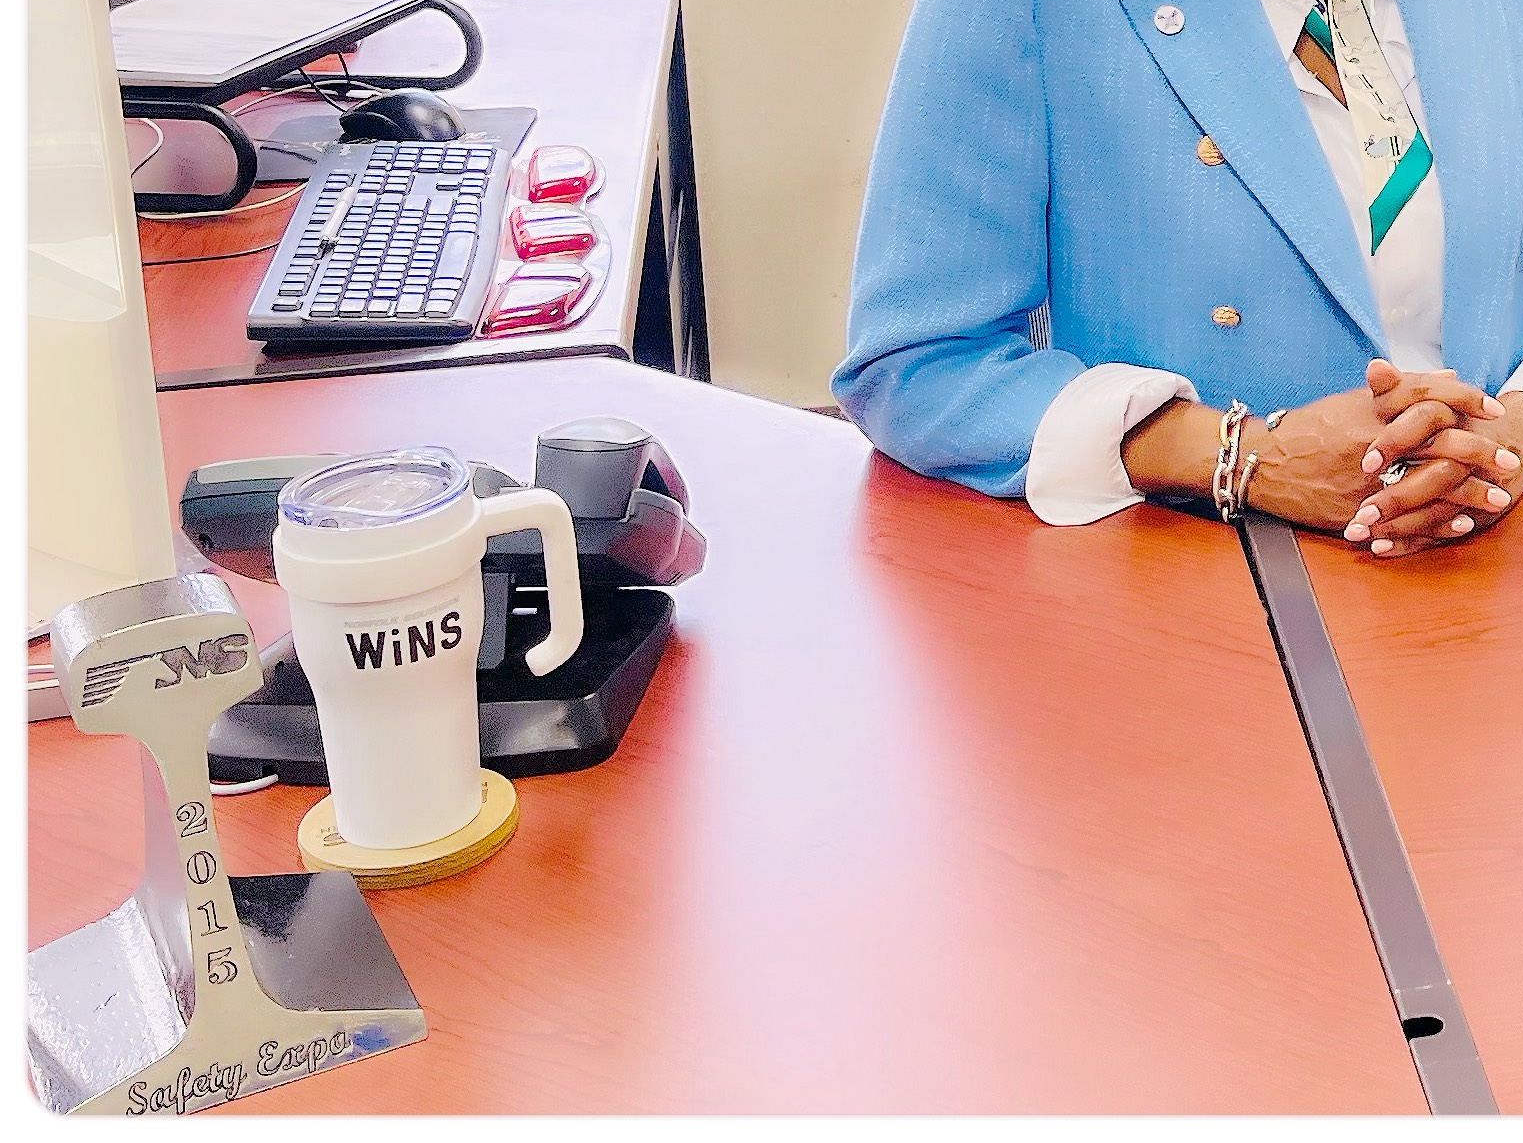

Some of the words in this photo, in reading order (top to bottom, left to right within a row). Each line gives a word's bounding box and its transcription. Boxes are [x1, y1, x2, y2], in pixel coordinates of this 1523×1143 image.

[154, 633, 249, 690] NS
[344, 610, 463, 671] WiNS
[175, 799, 239, 985] 2015
[125, 1054, 248, 1118] Safety
[256, 1028, 353, 1078] Expo
